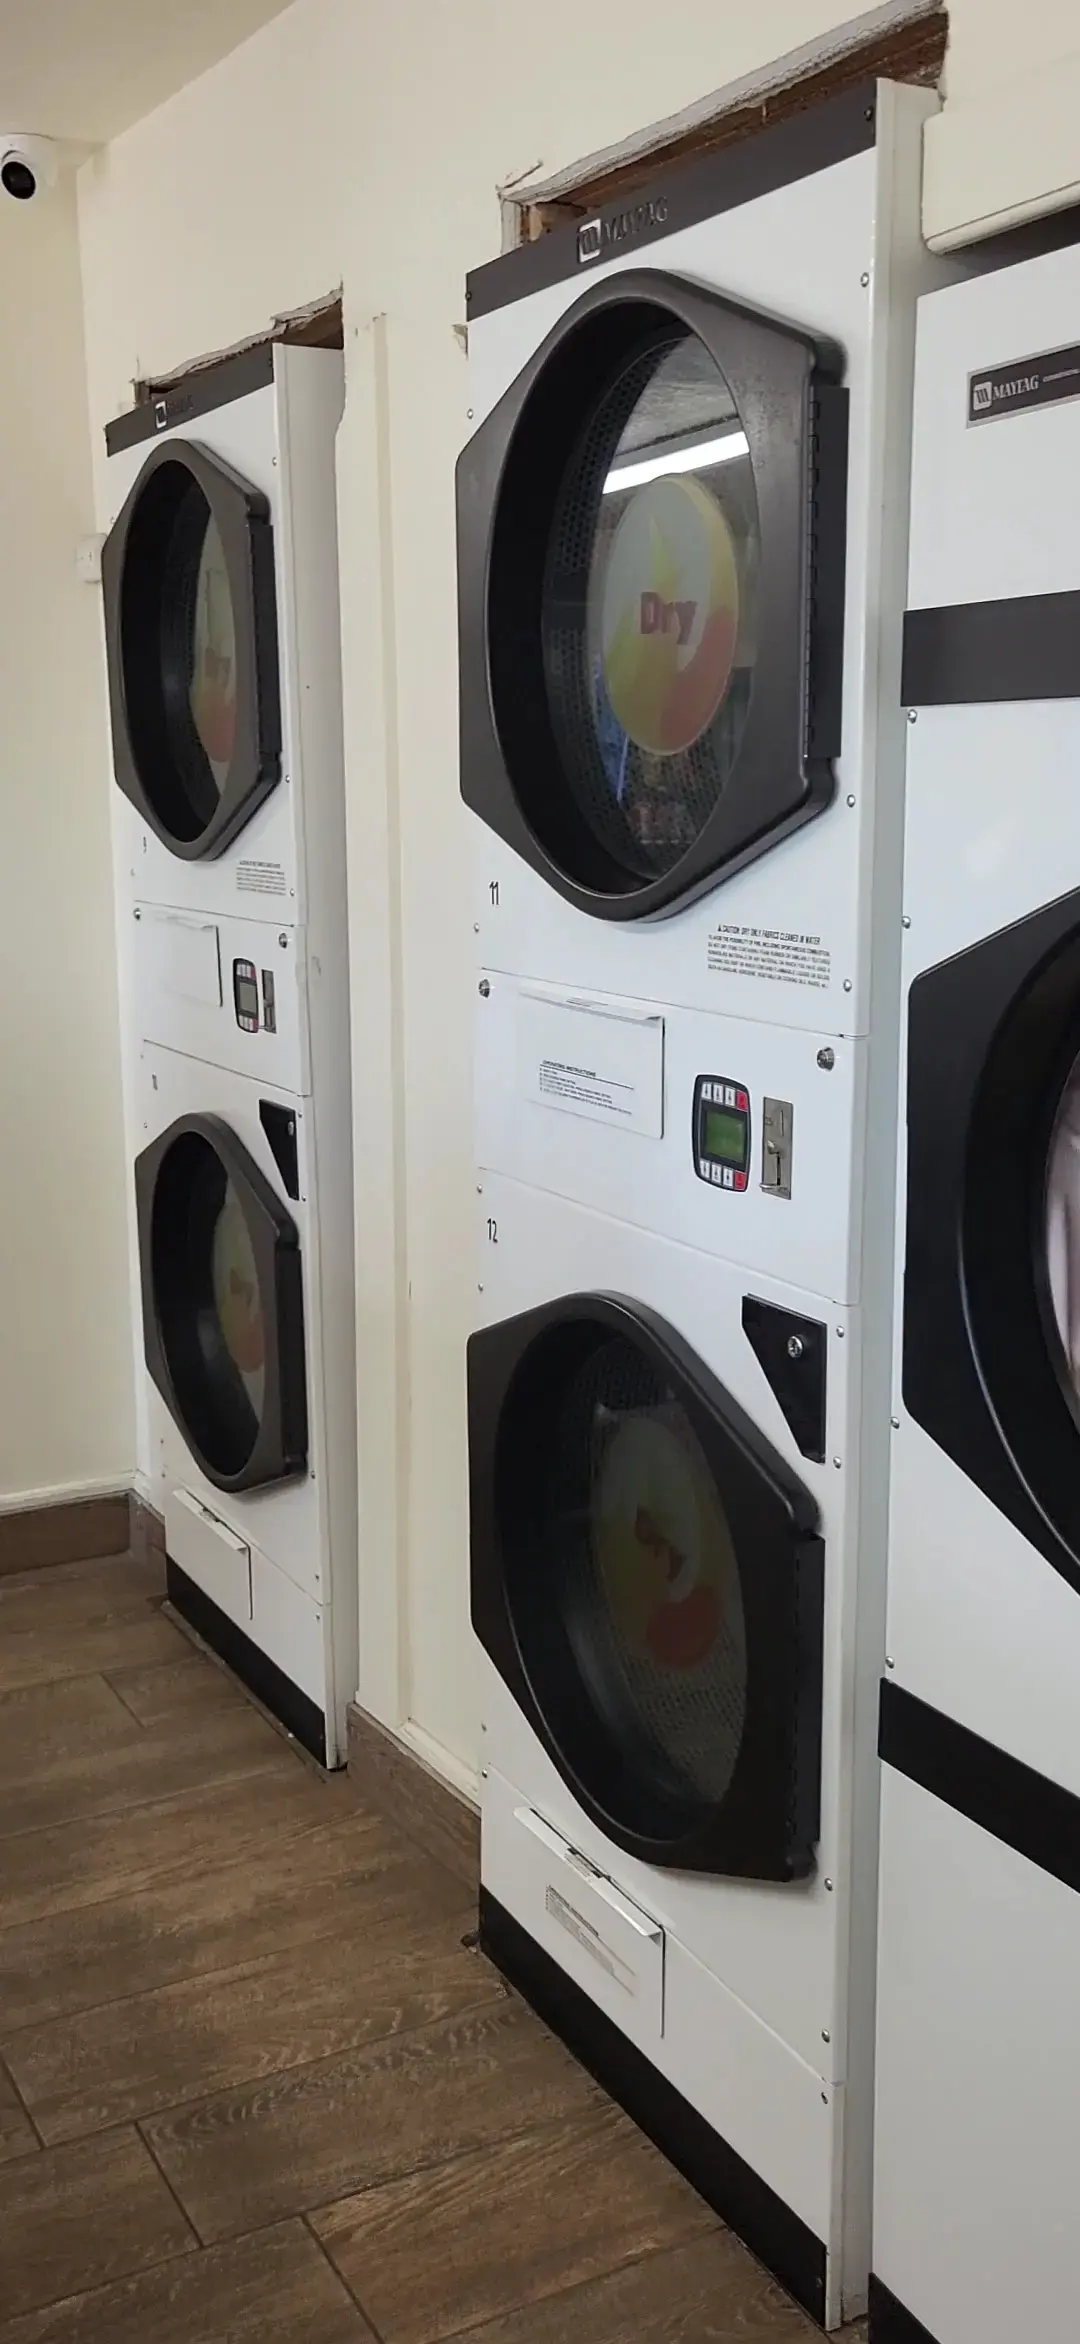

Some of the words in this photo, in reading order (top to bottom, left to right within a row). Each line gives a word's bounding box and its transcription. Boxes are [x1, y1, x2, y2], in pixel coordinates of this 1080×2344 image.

[603, 196, 668, 246] MAYTAG
[992, 374, 1040, 400] MAYTAG
[640, 591, 697, 646] Dry
[488, 881, 499, 905] 11
[487, 1217, 498, 1243] 12
